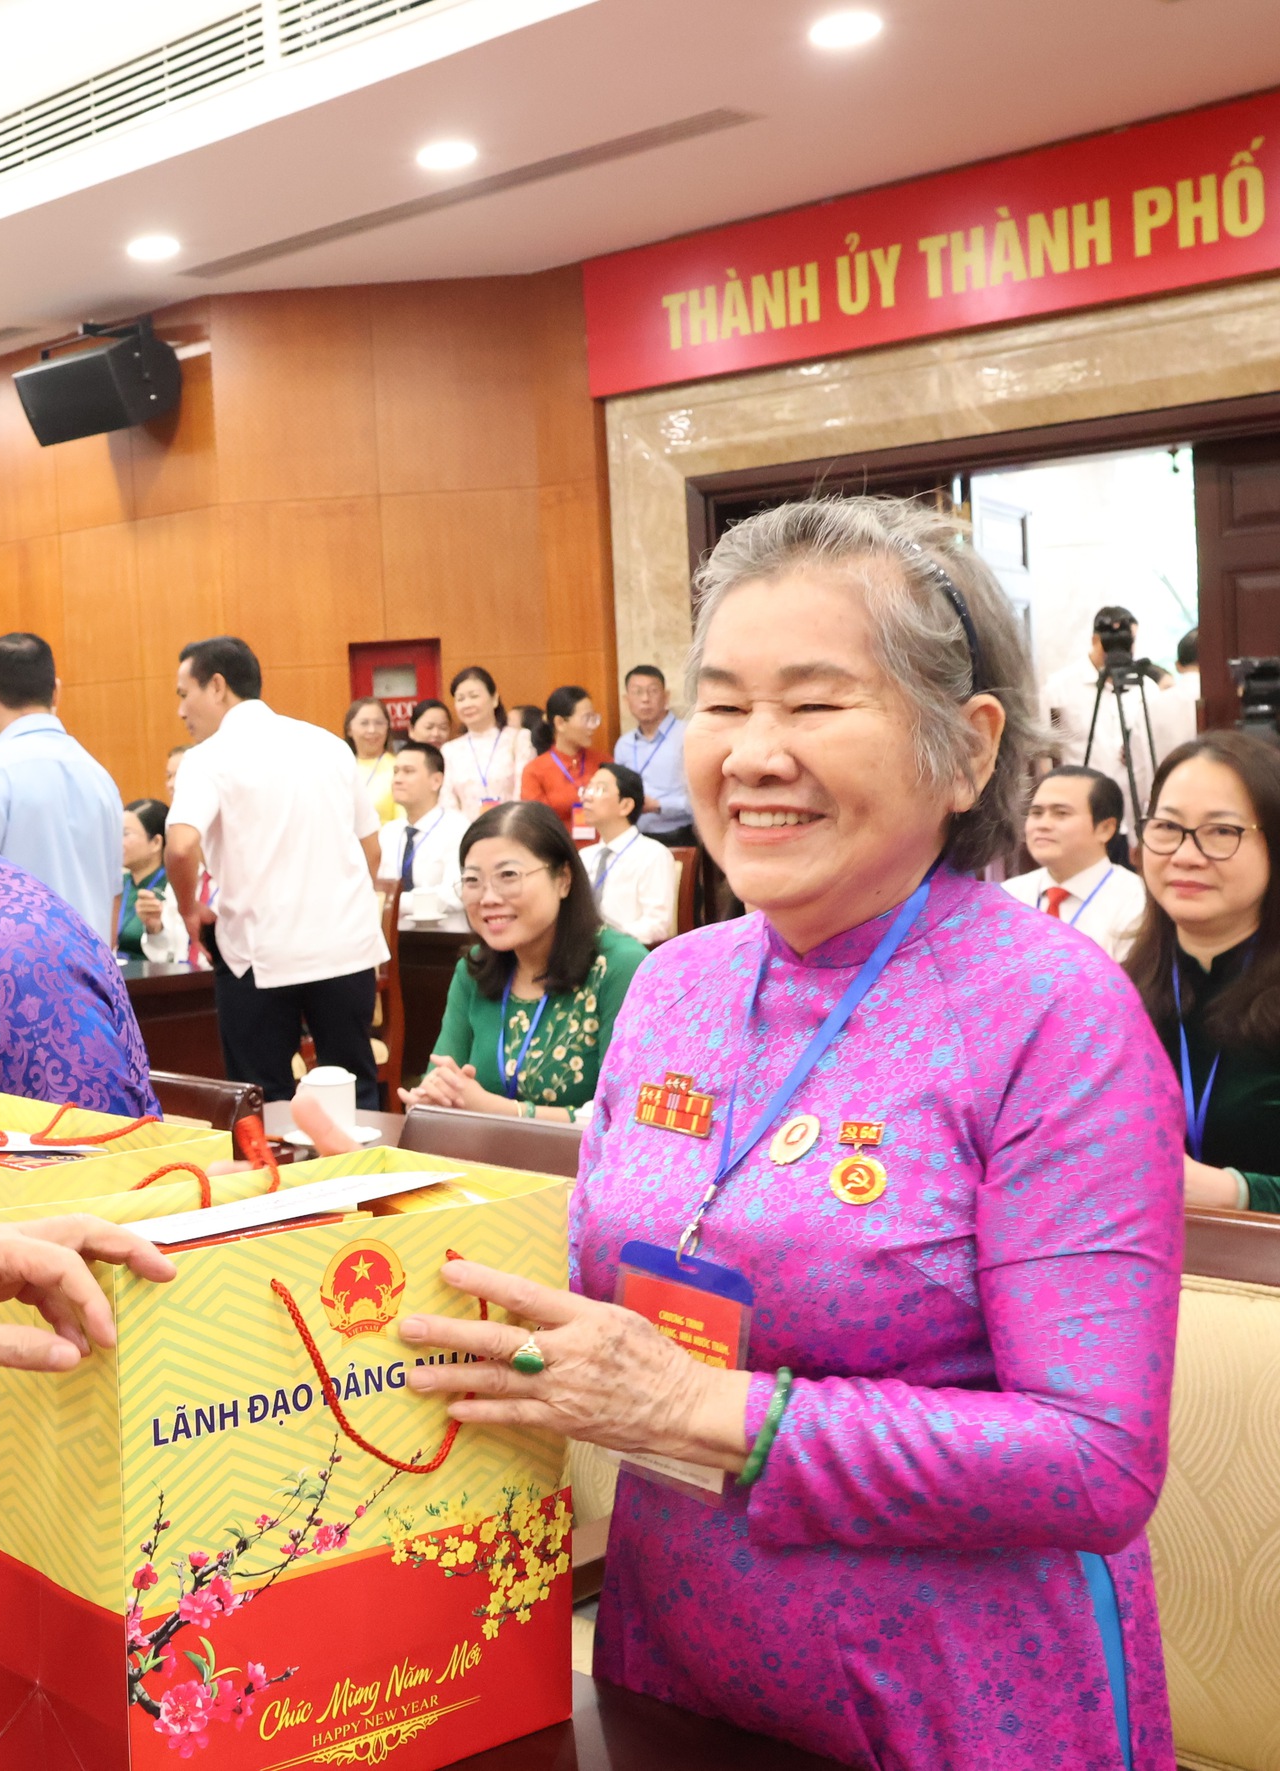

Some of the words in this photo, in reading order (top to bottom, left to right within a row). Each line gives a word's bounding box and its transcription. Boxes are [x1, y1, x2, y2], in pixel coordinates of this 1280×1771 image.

[662, 262, 820, 351] THÀNH
[835, 231, 902, 316] ỦY
[918, 197, 1112, 300] THÀNH
[1133, 135, 1266, 258] PHỐ
[152, 1400, 239, 1447] LÃNH
[247, 1384, 313, 1427] ĐẠO
[320, 1362, 407, 1405] ĐẢNG
[259, 1697, 314, 1741] Chúc
[316, 1677, 381, 1724] Mừng
[385, 1656, 434, 1703] Năm
[435, 1639, 483, 1685] Mới
[312, 1720, 361, 1748] HAPPY
[364, 1707, 399, 1731] NEW
[401, 1694, 440, 1717] YEAR
